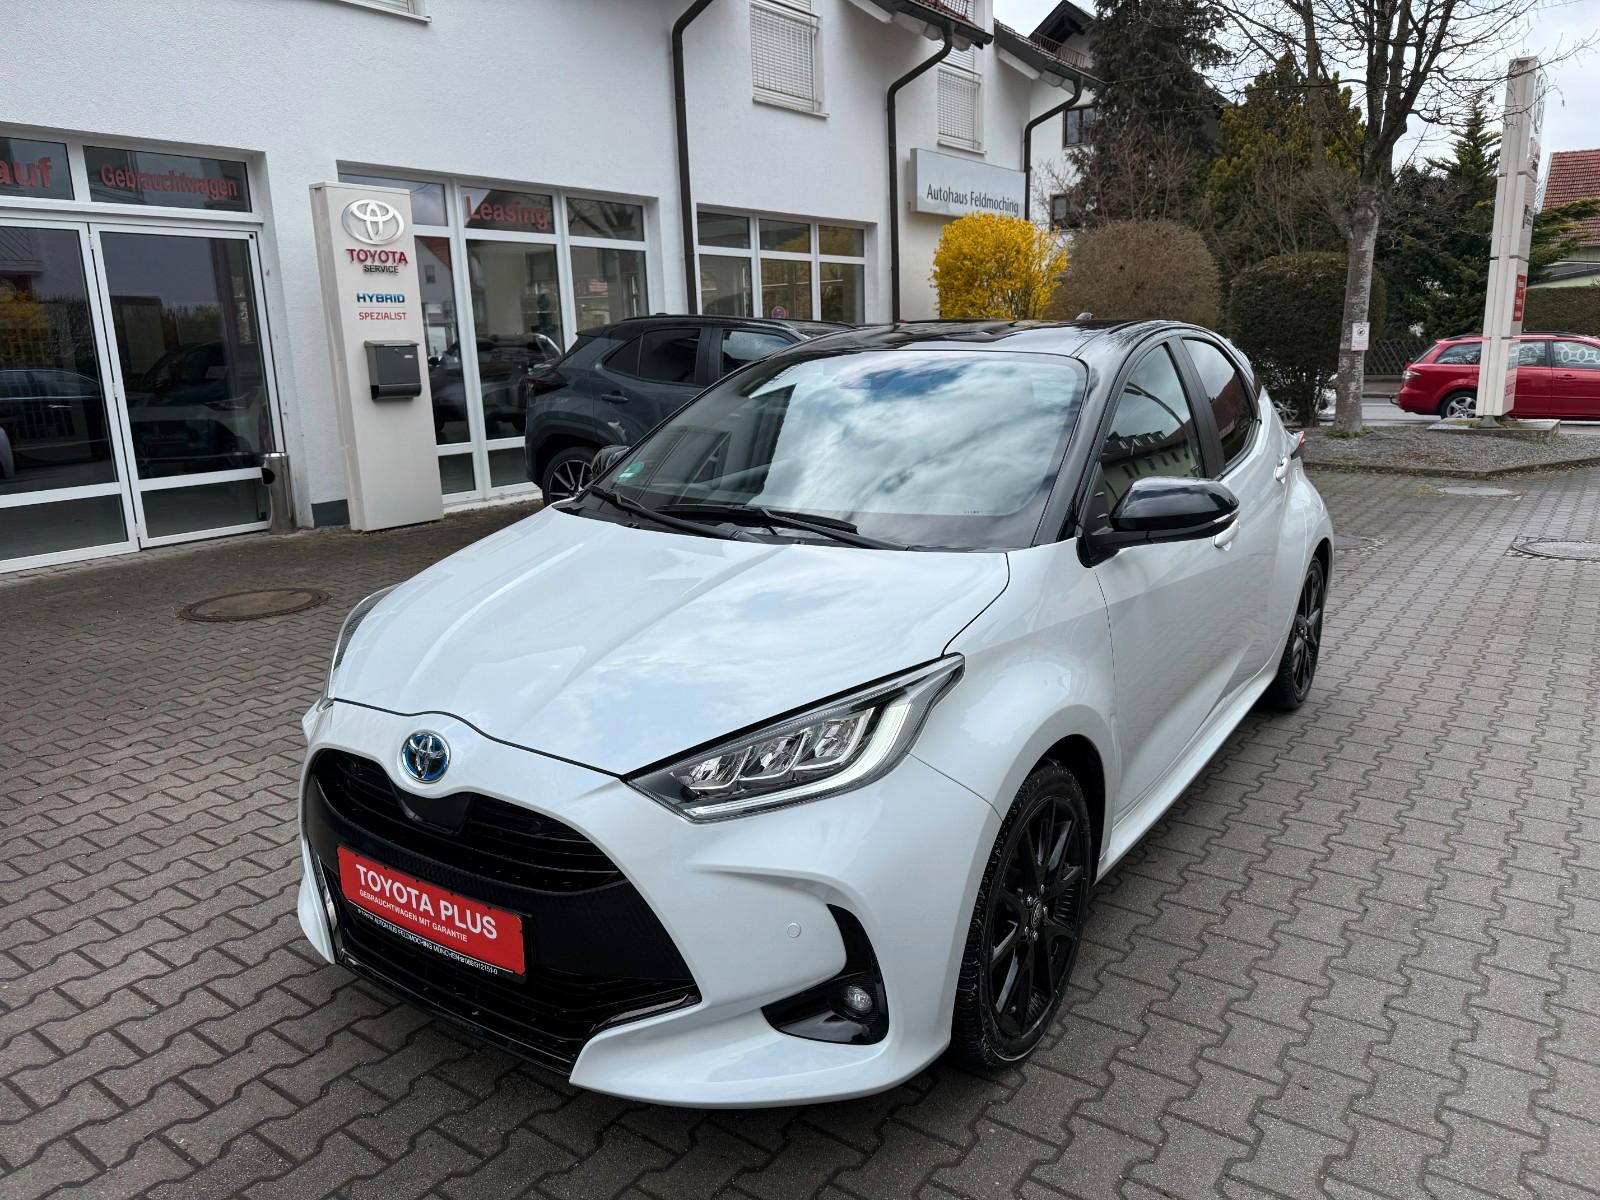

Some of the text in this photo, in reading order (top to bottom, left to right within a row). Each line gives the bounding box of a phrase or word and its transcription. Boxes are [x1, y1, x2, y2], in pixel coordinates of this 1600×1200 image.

[101, 164, 238, 199] Gebrauchtwagen
[464, 196, 549, 231] Leasing
[926, 184, 1019, 217] Autohaus Feldmoching
[345, 249, 408, 265] TOYOTA
[363, 265, 399, 273] SERVICE
[356, 293, 406, 303] HYBRID
[358, 312, 407, 321] SPEZIALIST
[355, 863, 498, 940] TOYOTA PLUS
[359, 889, 468, 943] GEBRAUCHTWAGEN MIT GARANTIE
[374, 917, 398, 934] AUTOHAUS
[397, 929, 433, 950] FELDMOCHING
